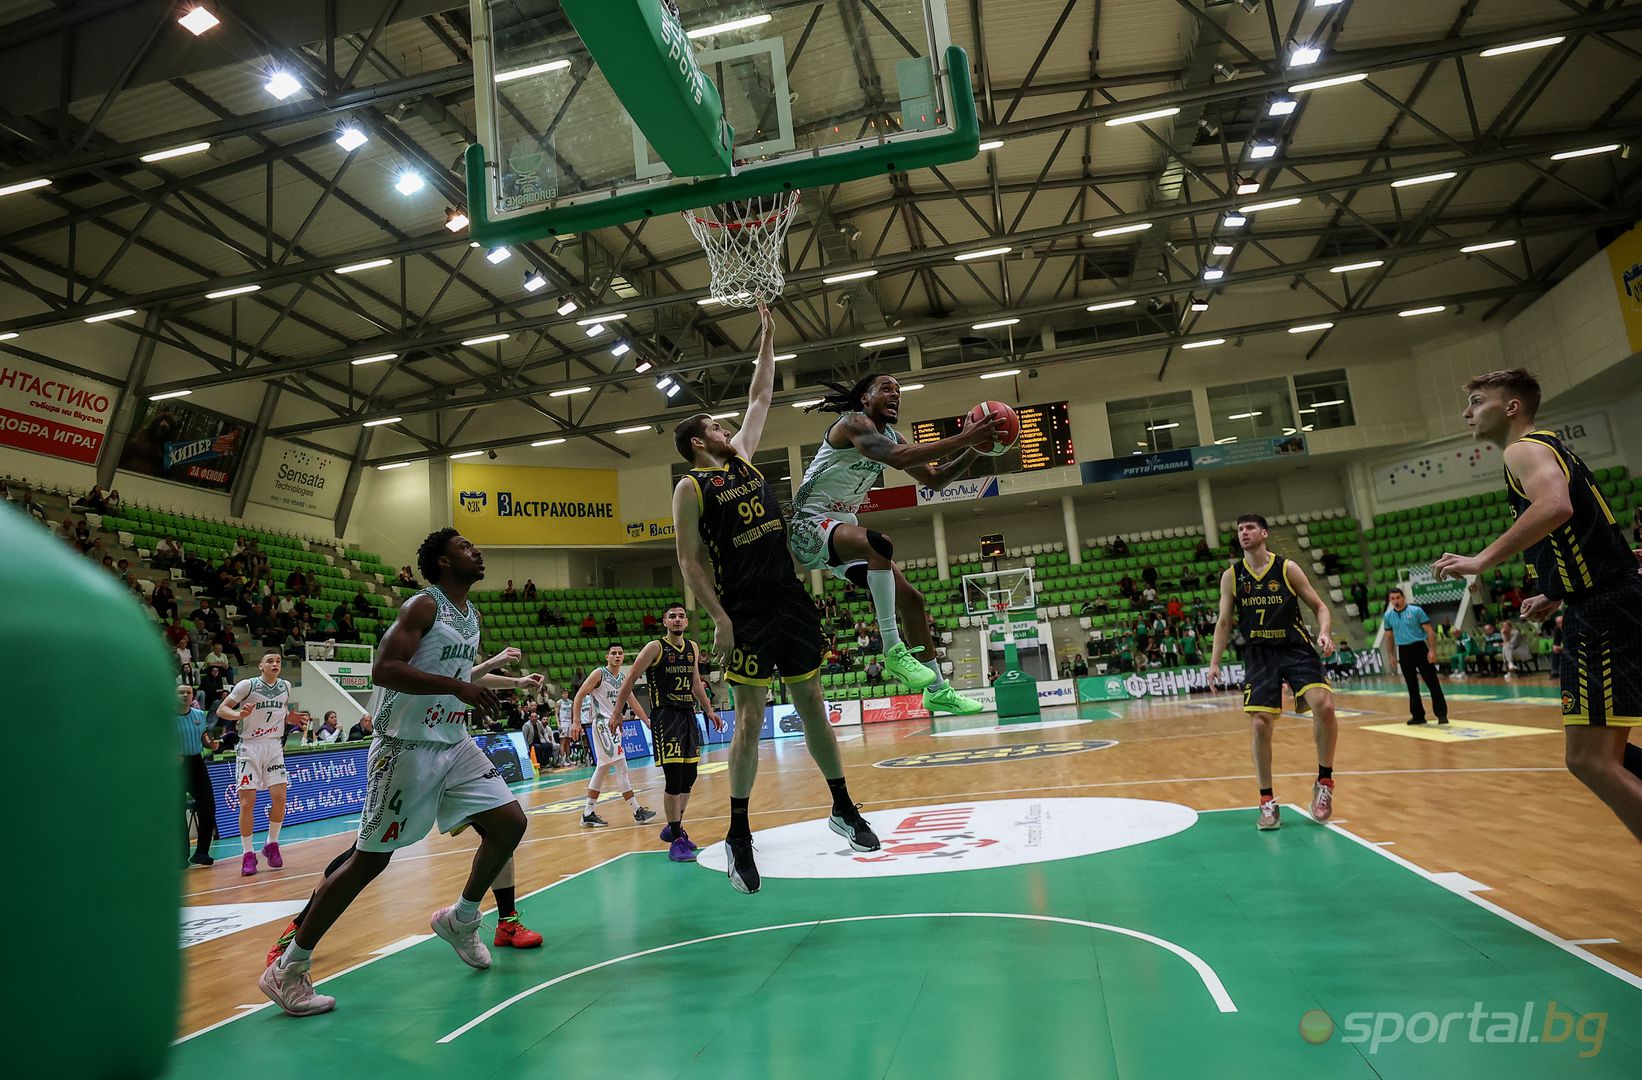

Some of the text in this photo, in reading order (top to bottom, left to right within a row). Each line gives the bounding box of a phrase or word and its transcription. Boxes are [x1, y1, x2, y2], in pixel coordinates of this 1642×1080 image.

[53, 429, 96, 449] ИГРА!
[278, 463, 325, 489] Sensata
[1124, 460, 1189, 475] PHYTO PHARMA
[274, 480, 314, 497] Technologies
[716, 483, 750, 505] MINYOR
[497, 492, 613, 518] ЗАСТРАХОВАНЕ
[738, 495, 765, 525] 96
[1267, 595, 1283, 605] 2015
[1255, 608, 1266, 625] 7
[665, 666, 687, 674] MINYOR
[732, 648, 759, 676] 96
[674, 677, 691, 691] 24
[1244, 689, 1251, 705] 7
[266, 711, 273, 723] 7
[666, 743, 681, 757] 24
[240, 761, 246, 773] 7
[312, 757, 357, 785] Hybrid
[318, 787, 344, 807] 462
[388, 789, 402, 815] 4
[380, 817, 408, 843] A1
